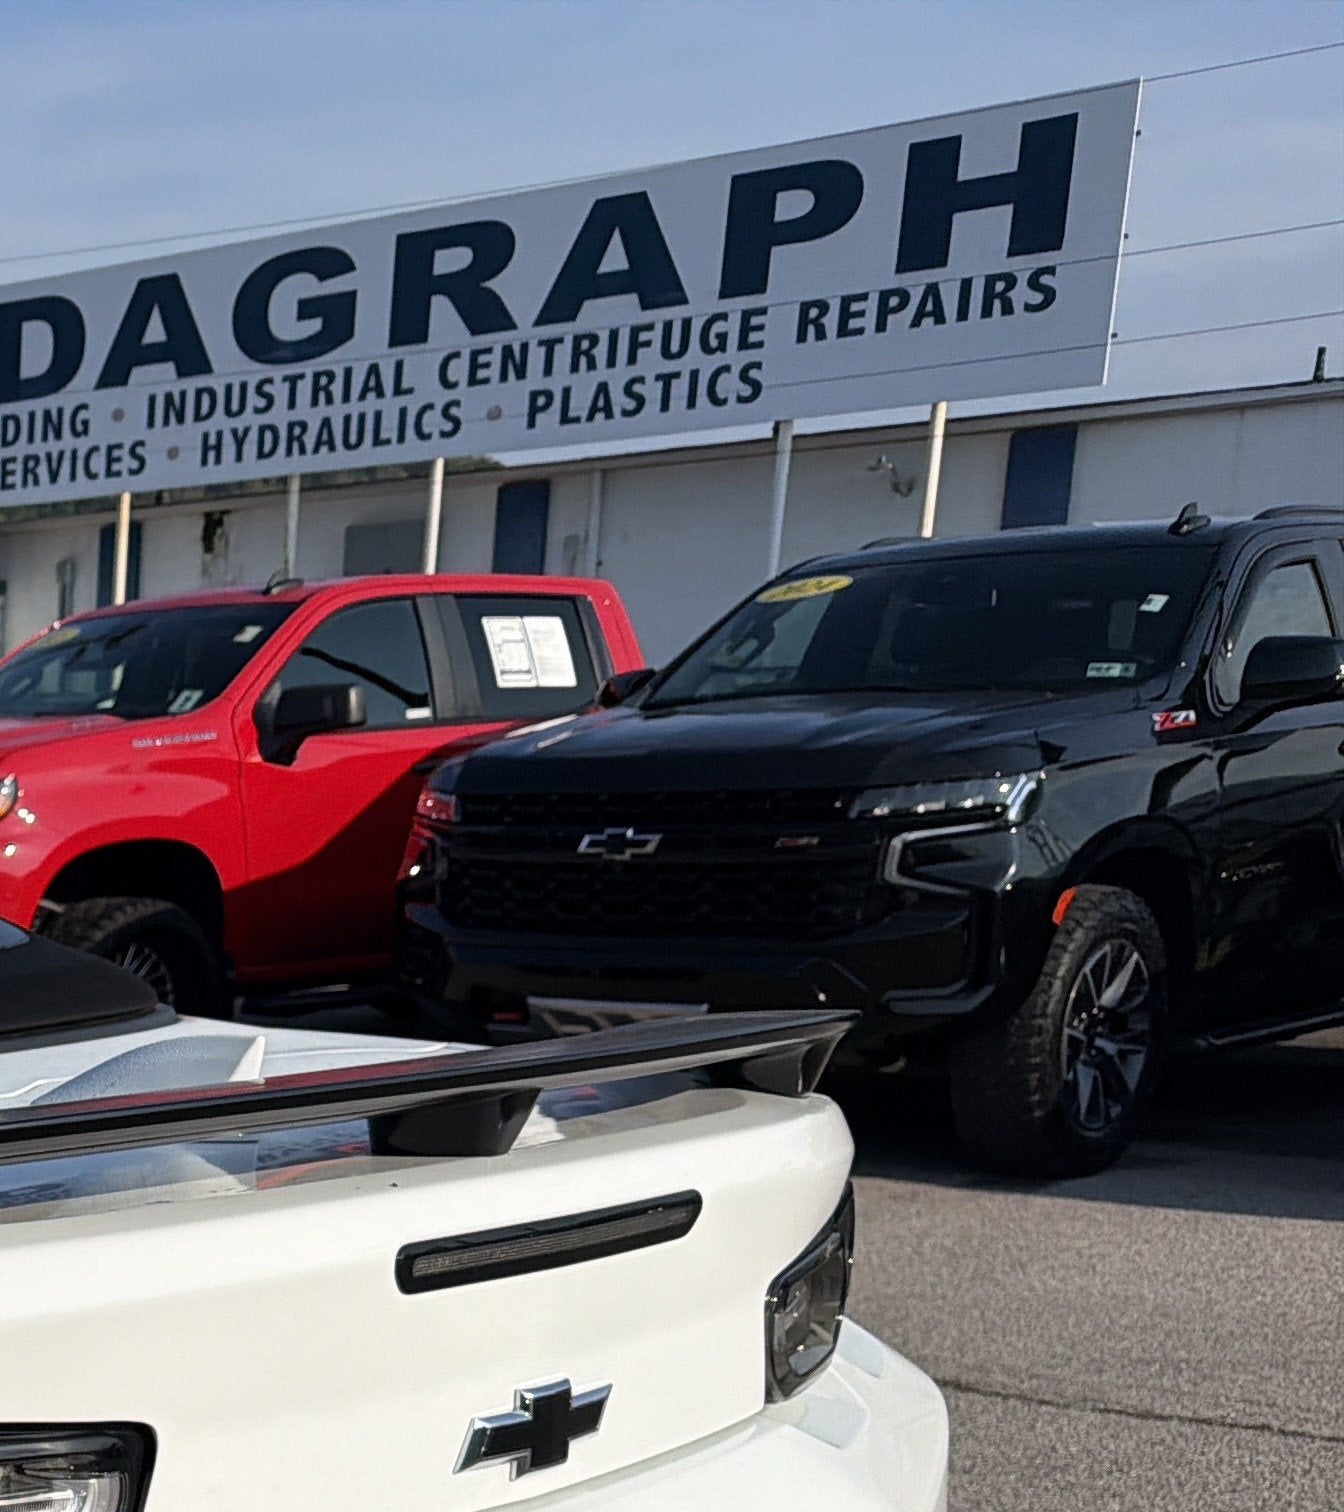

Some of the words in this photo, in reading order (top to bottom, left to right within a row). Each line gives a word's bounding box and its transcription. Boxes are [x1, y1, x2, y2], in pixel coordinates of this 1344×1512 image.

[145, 358, 415, 429] INDUSTRIAL
[438, 307, 769, 390] CENTRIFUGE
[795, 265, 1058, 345] REPAIRS
[199, 400, 463, 468] HYDRAULICS
[526, 360, 765, 431] PLASTICS
